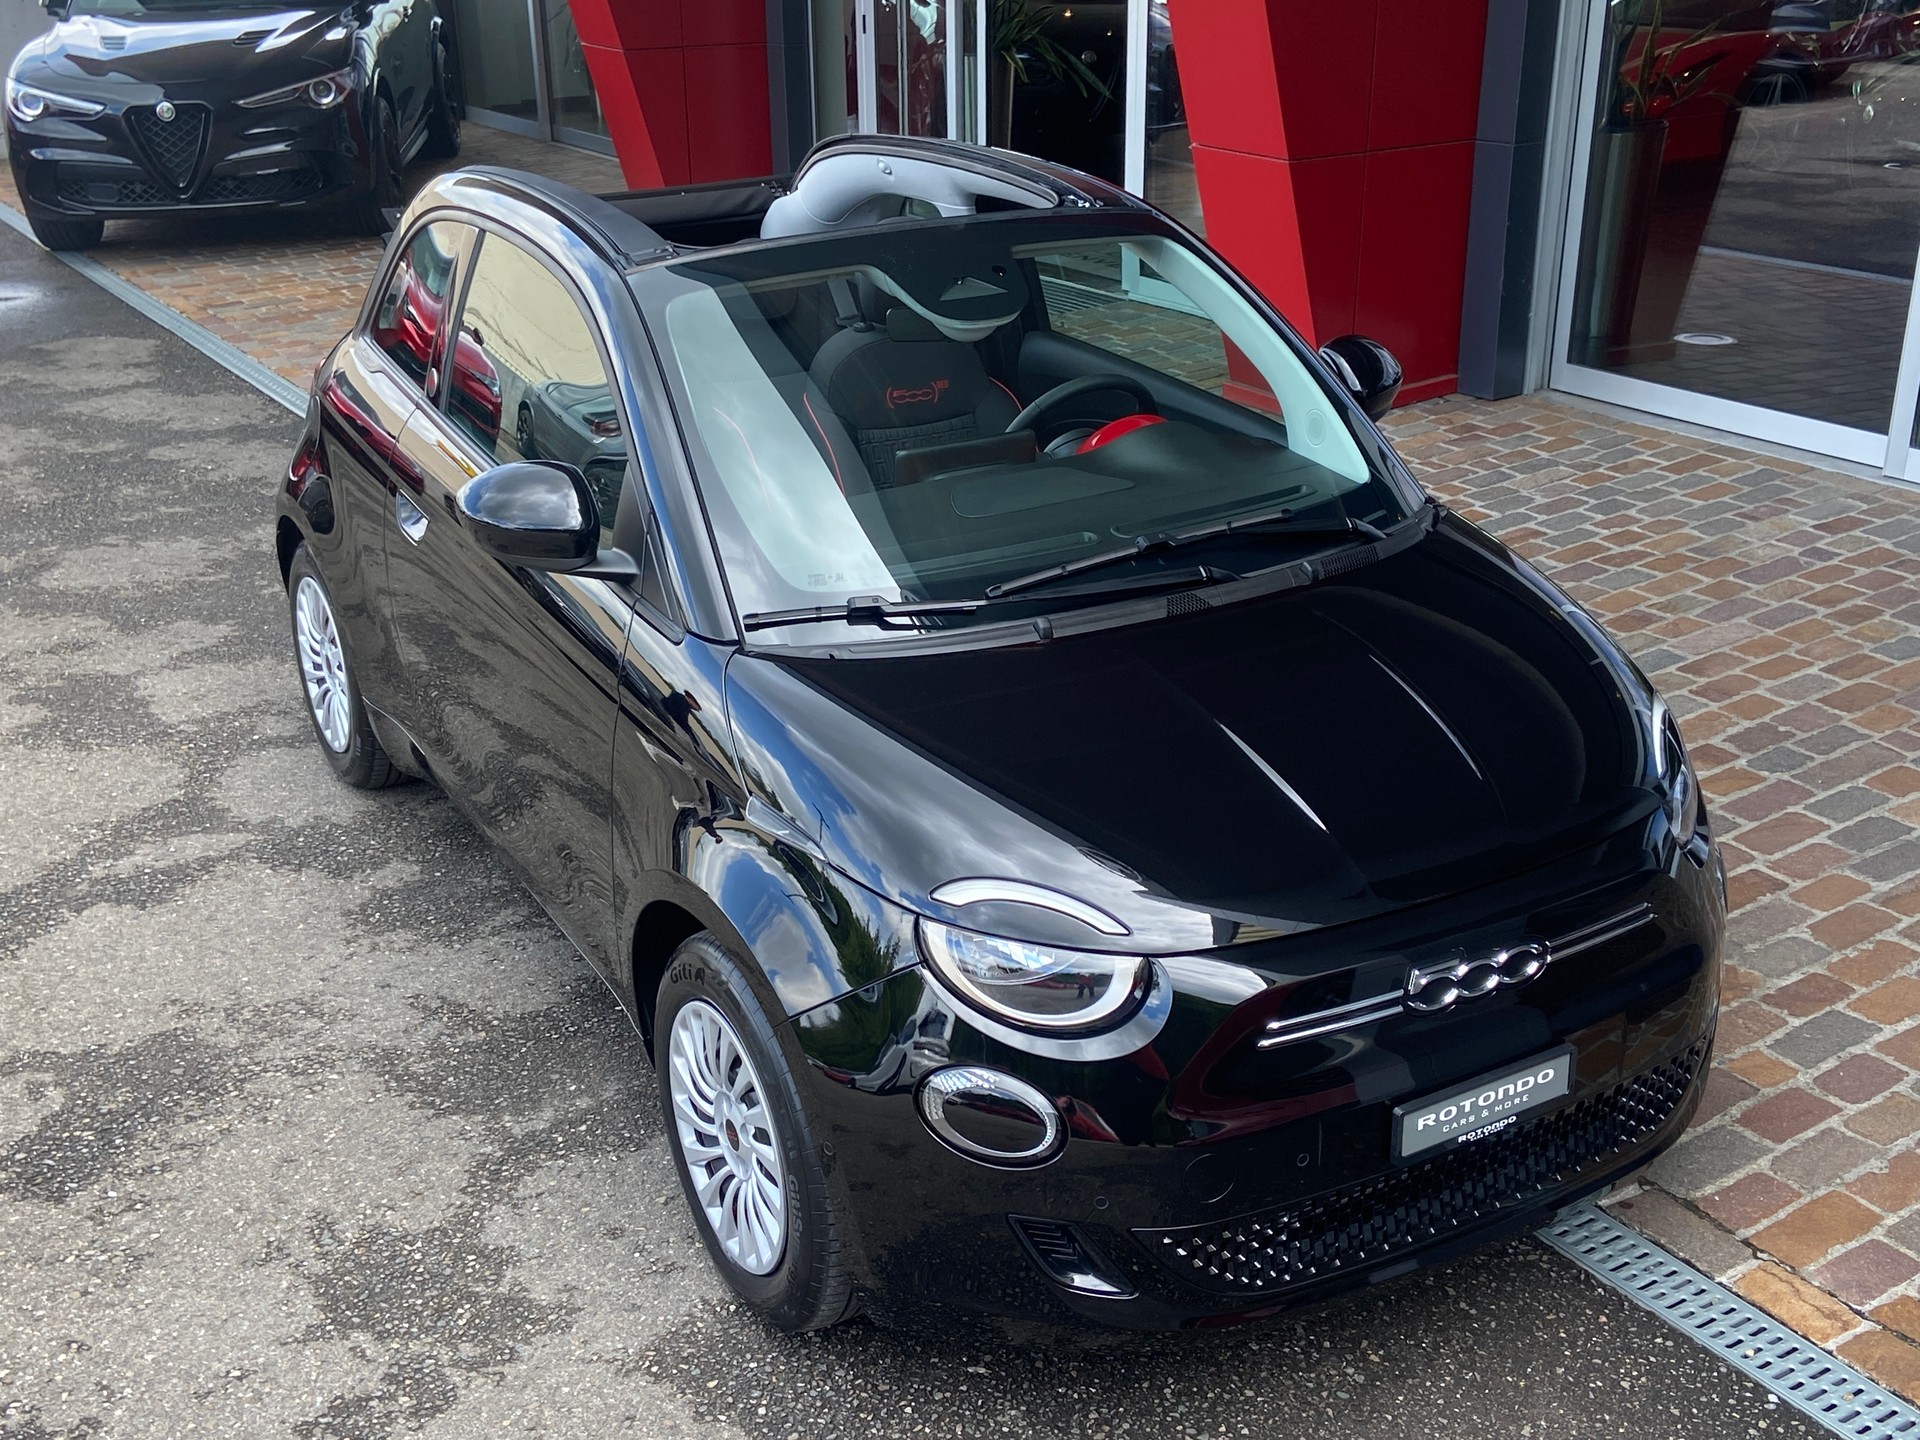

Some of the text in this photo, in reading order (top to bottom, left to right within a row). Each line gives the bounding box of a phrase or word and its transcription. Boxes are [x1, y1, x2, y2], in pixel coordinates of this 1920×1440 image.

[670, 963, 693, 984] Giti
[1407, 943, 1548, 1011] 500
[1417, 1068, 1554, 1131] ROTONDO
[1442, 1094, 1529, 1133] CARS & MORE
[1458, 1115, 1517, 1143] ROTONDO
